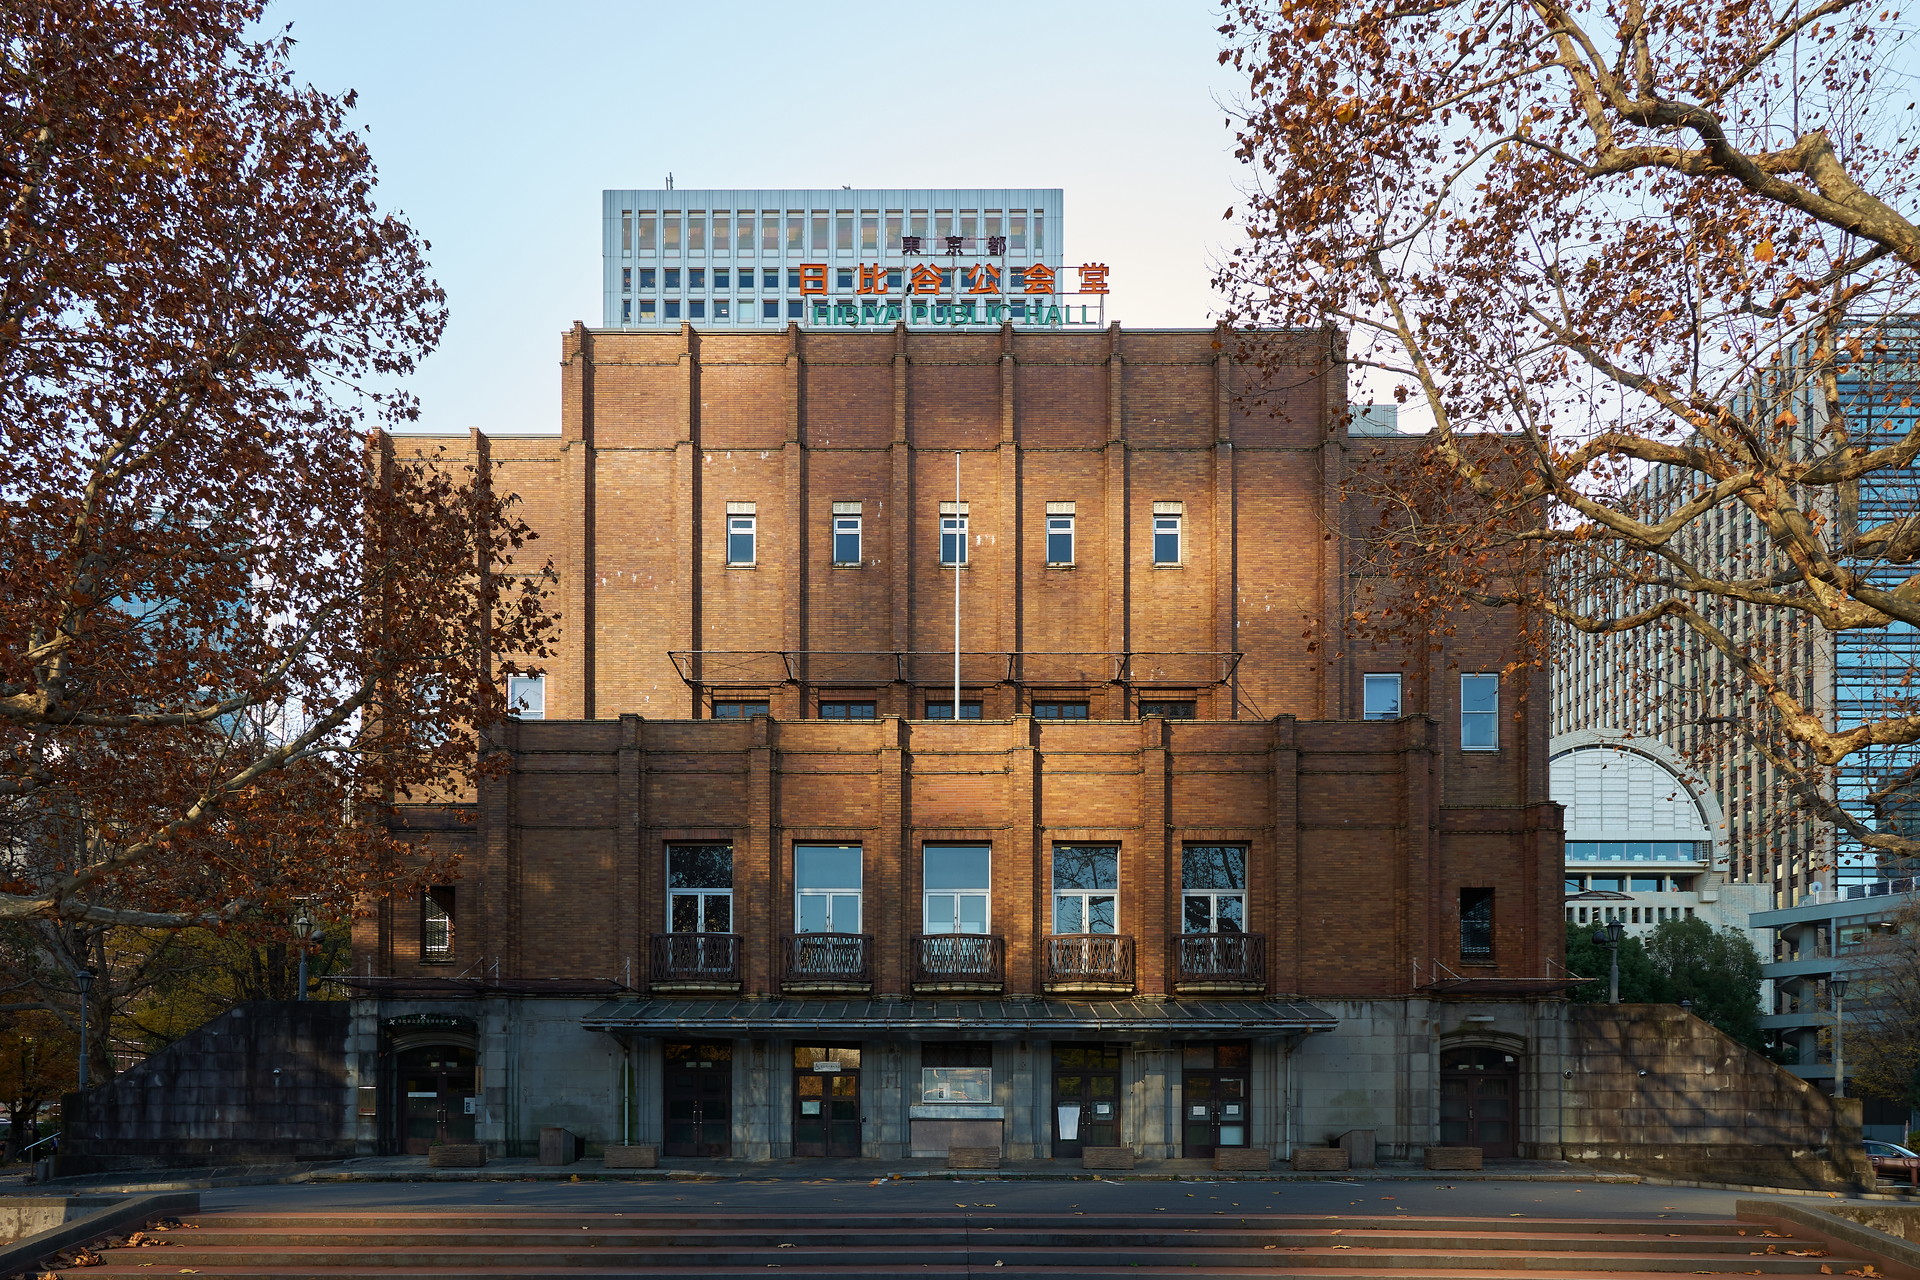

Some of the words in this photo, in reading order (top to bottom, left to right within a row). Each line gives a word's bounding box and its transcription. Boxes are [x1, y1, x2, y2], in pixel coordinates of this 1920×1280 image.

[902, 236, 1007, 256] 東京都
[799, 262, 1110, 295] 日比谷公会堂
[813, 304, 901, 325] HIBIYA
[912, 304, 1013, 325] PUBLIC
[1025, 304, 1097, 325] HALL
